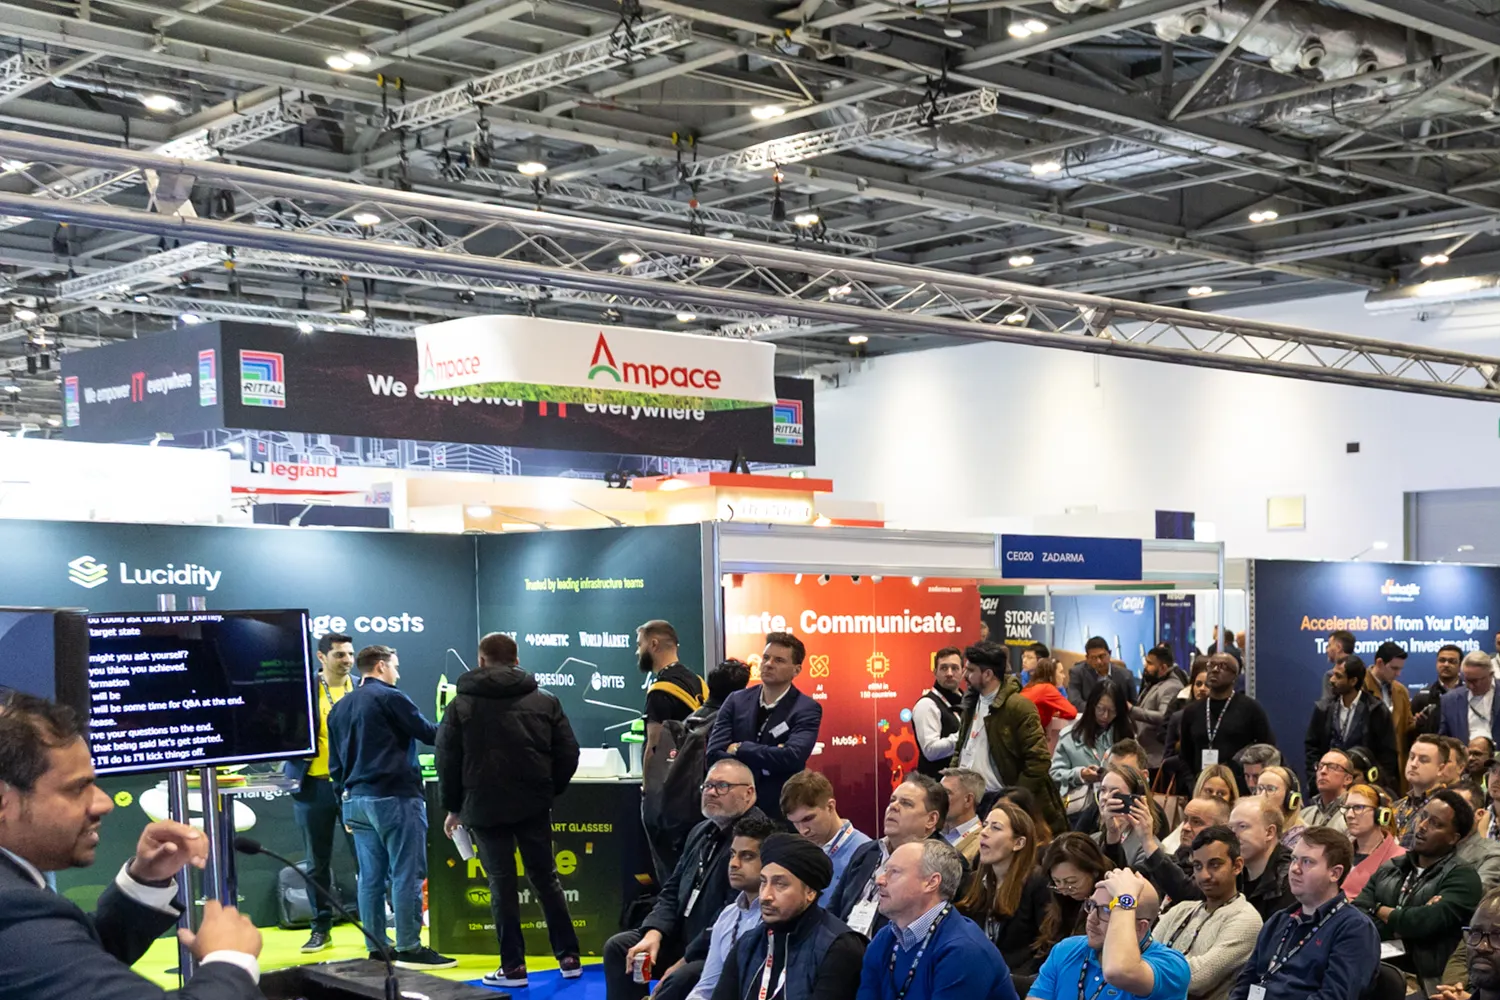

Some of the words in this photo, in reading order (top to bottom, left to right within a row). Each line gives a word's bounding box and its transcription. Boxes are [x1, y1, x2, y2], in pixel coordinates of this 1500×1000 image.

[423, 342, 481, 381] Ampace
[588, 331, 721, 389] Ampace
[131, 371, 145, 402] IT
[243, 382, 284, 395] RITTAL
[367, 374, 407, 397] We
[775, 425, 802, 435] RITTAL
[271, 462, 338, 481] legrand
[1006, 551, 1034, 562] CE020
[1042, 552, 1085, 563] ZADARMA
[120, 562, 222, 591] Lucidity
[524, 578, 547, 590] Trusted
[547, 578, 556, 593] by
[557, 577, 580, 593] leading
[580, 577, 623, 589] infrastructure
[623, 577, 644, 589] teams
[980, 598, 999, 609] GH
[800, 609, 961, 634] Communicate.
[1005, 610, 1055, 625] STORAGE
[308, 614, 347, 639] ge
[354, 612, 425, 633] costs
[1005, 624, 1032, 638] TANK
[1300, 616, 1368, 632] Accelerate
[1370, 616, 1393, 631] ROI
[1394, 616, 1423, 631] from
[1425, 616, 1452, 631] Your
[1454, 616, 1489, 634] Digital
[89, 628, 117, 638] target
[118, 628, 141, 636] state
[535, 633, 569, 647] DOMETIC
[88, 654, 115, 664] might
[116, 654, 133, 662] you
[134, 651, 150, 660] ask
[151, 650, 189, 662] yourself?
[88, 667, 105, 677] you
[106, 665, 130, 675] think
[130, 666, 147, 675] you
[148, 663, 188, 673] achieved.
[601, 675, 625, 689] BYTES
[92, 692, 107, 701] will
[109, 691, 121, 700] be
[813, 692, 827, 700] tools
[93, 704, 108, 714] will
[110, 704, 121, 713] be
[123, 703, 146, 712] some
[148, 701, 167, 711] time
[168, 700, 181, 709] for
[182, 699, 201, 709] Q&A
[202, 698, 211, 707] at
[212, 697, 226, 706] the
[227, 696, 245, 705] end.
[90, 718, 117, 727] lease.
[107, 730, 127, 741] your
[128, 727, 168, 738] questions
[169, 726, 179, 735] to
[180, 723, 194, 733] the
[195, 722, 214, 732] end.
[93, 743, 111, 753] that
[113, 741, 138, 752] being
[138, 739, 157, 749] said
[158, 737, 176, 747] let's
[177, 737, 191, 747] get
[192, 734, 224, 745] started.
[832, 733, 867, 746] HubSpot
[110, 754, 122, 764] do
[123, 753, 132, 763] is
[146, 751, 164, 761] kick
[164, 749, 191, 760] things
[191, 747, 206, 757] off.
[568, 823, 613, 833] GLASSES!
[468, 922, 483, 931] 12th
